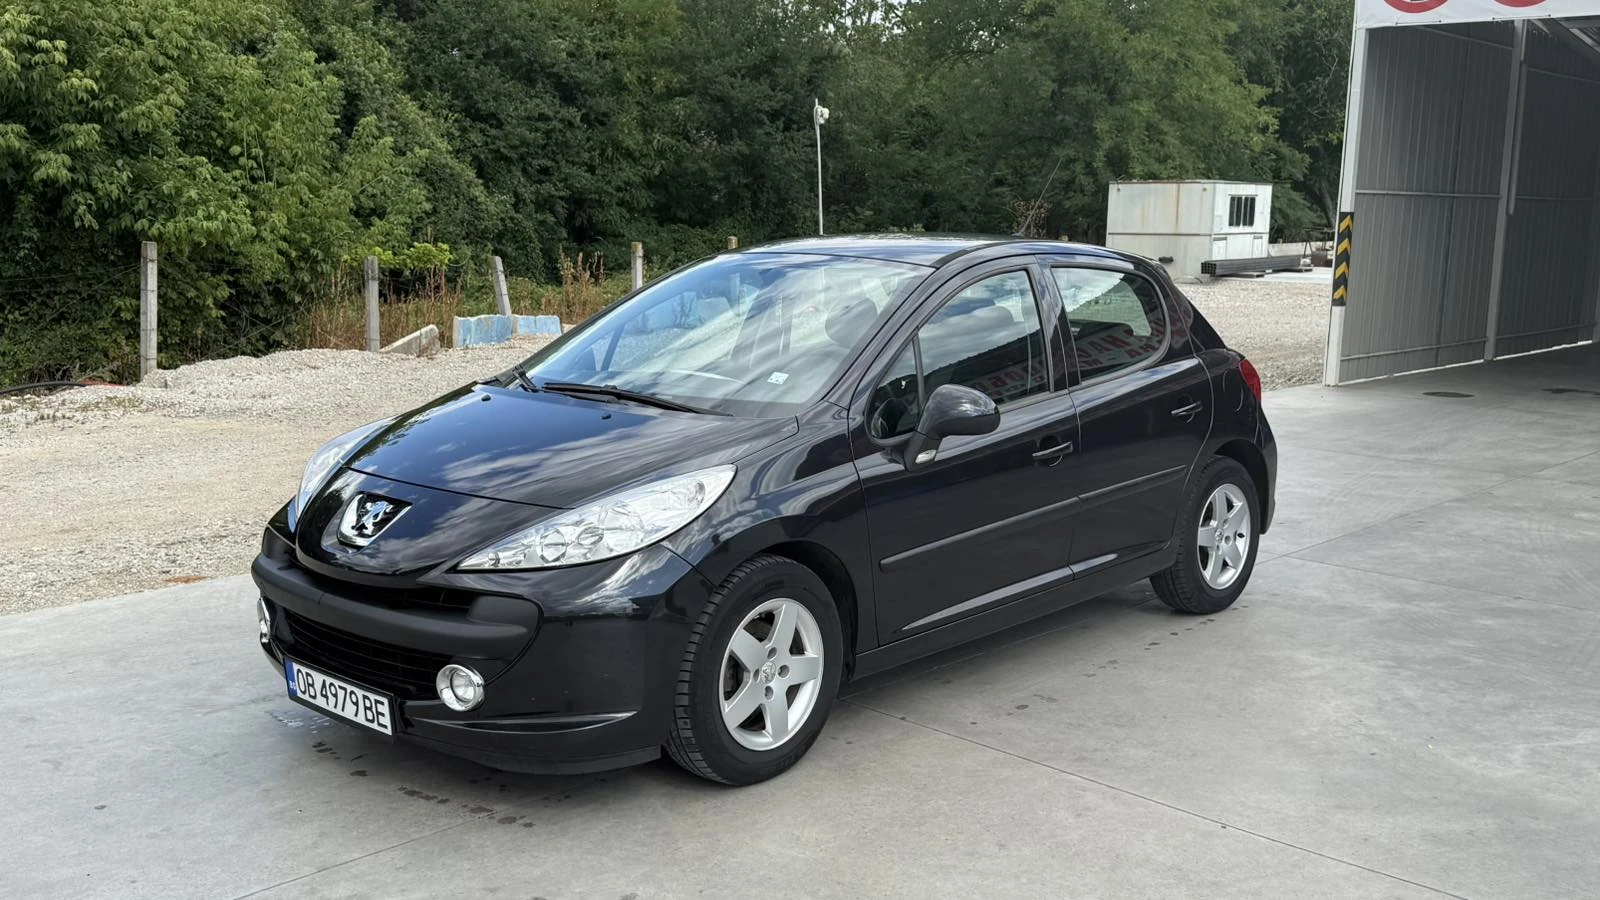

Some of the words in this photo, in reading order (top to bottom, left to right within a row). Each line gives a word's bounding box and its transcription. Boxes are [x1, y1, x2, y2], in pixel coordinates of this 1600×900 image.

[296, 668, 317, 700] OB
[320, 678, 360, 717] 4979
[362, 694, 389, 729] BE
